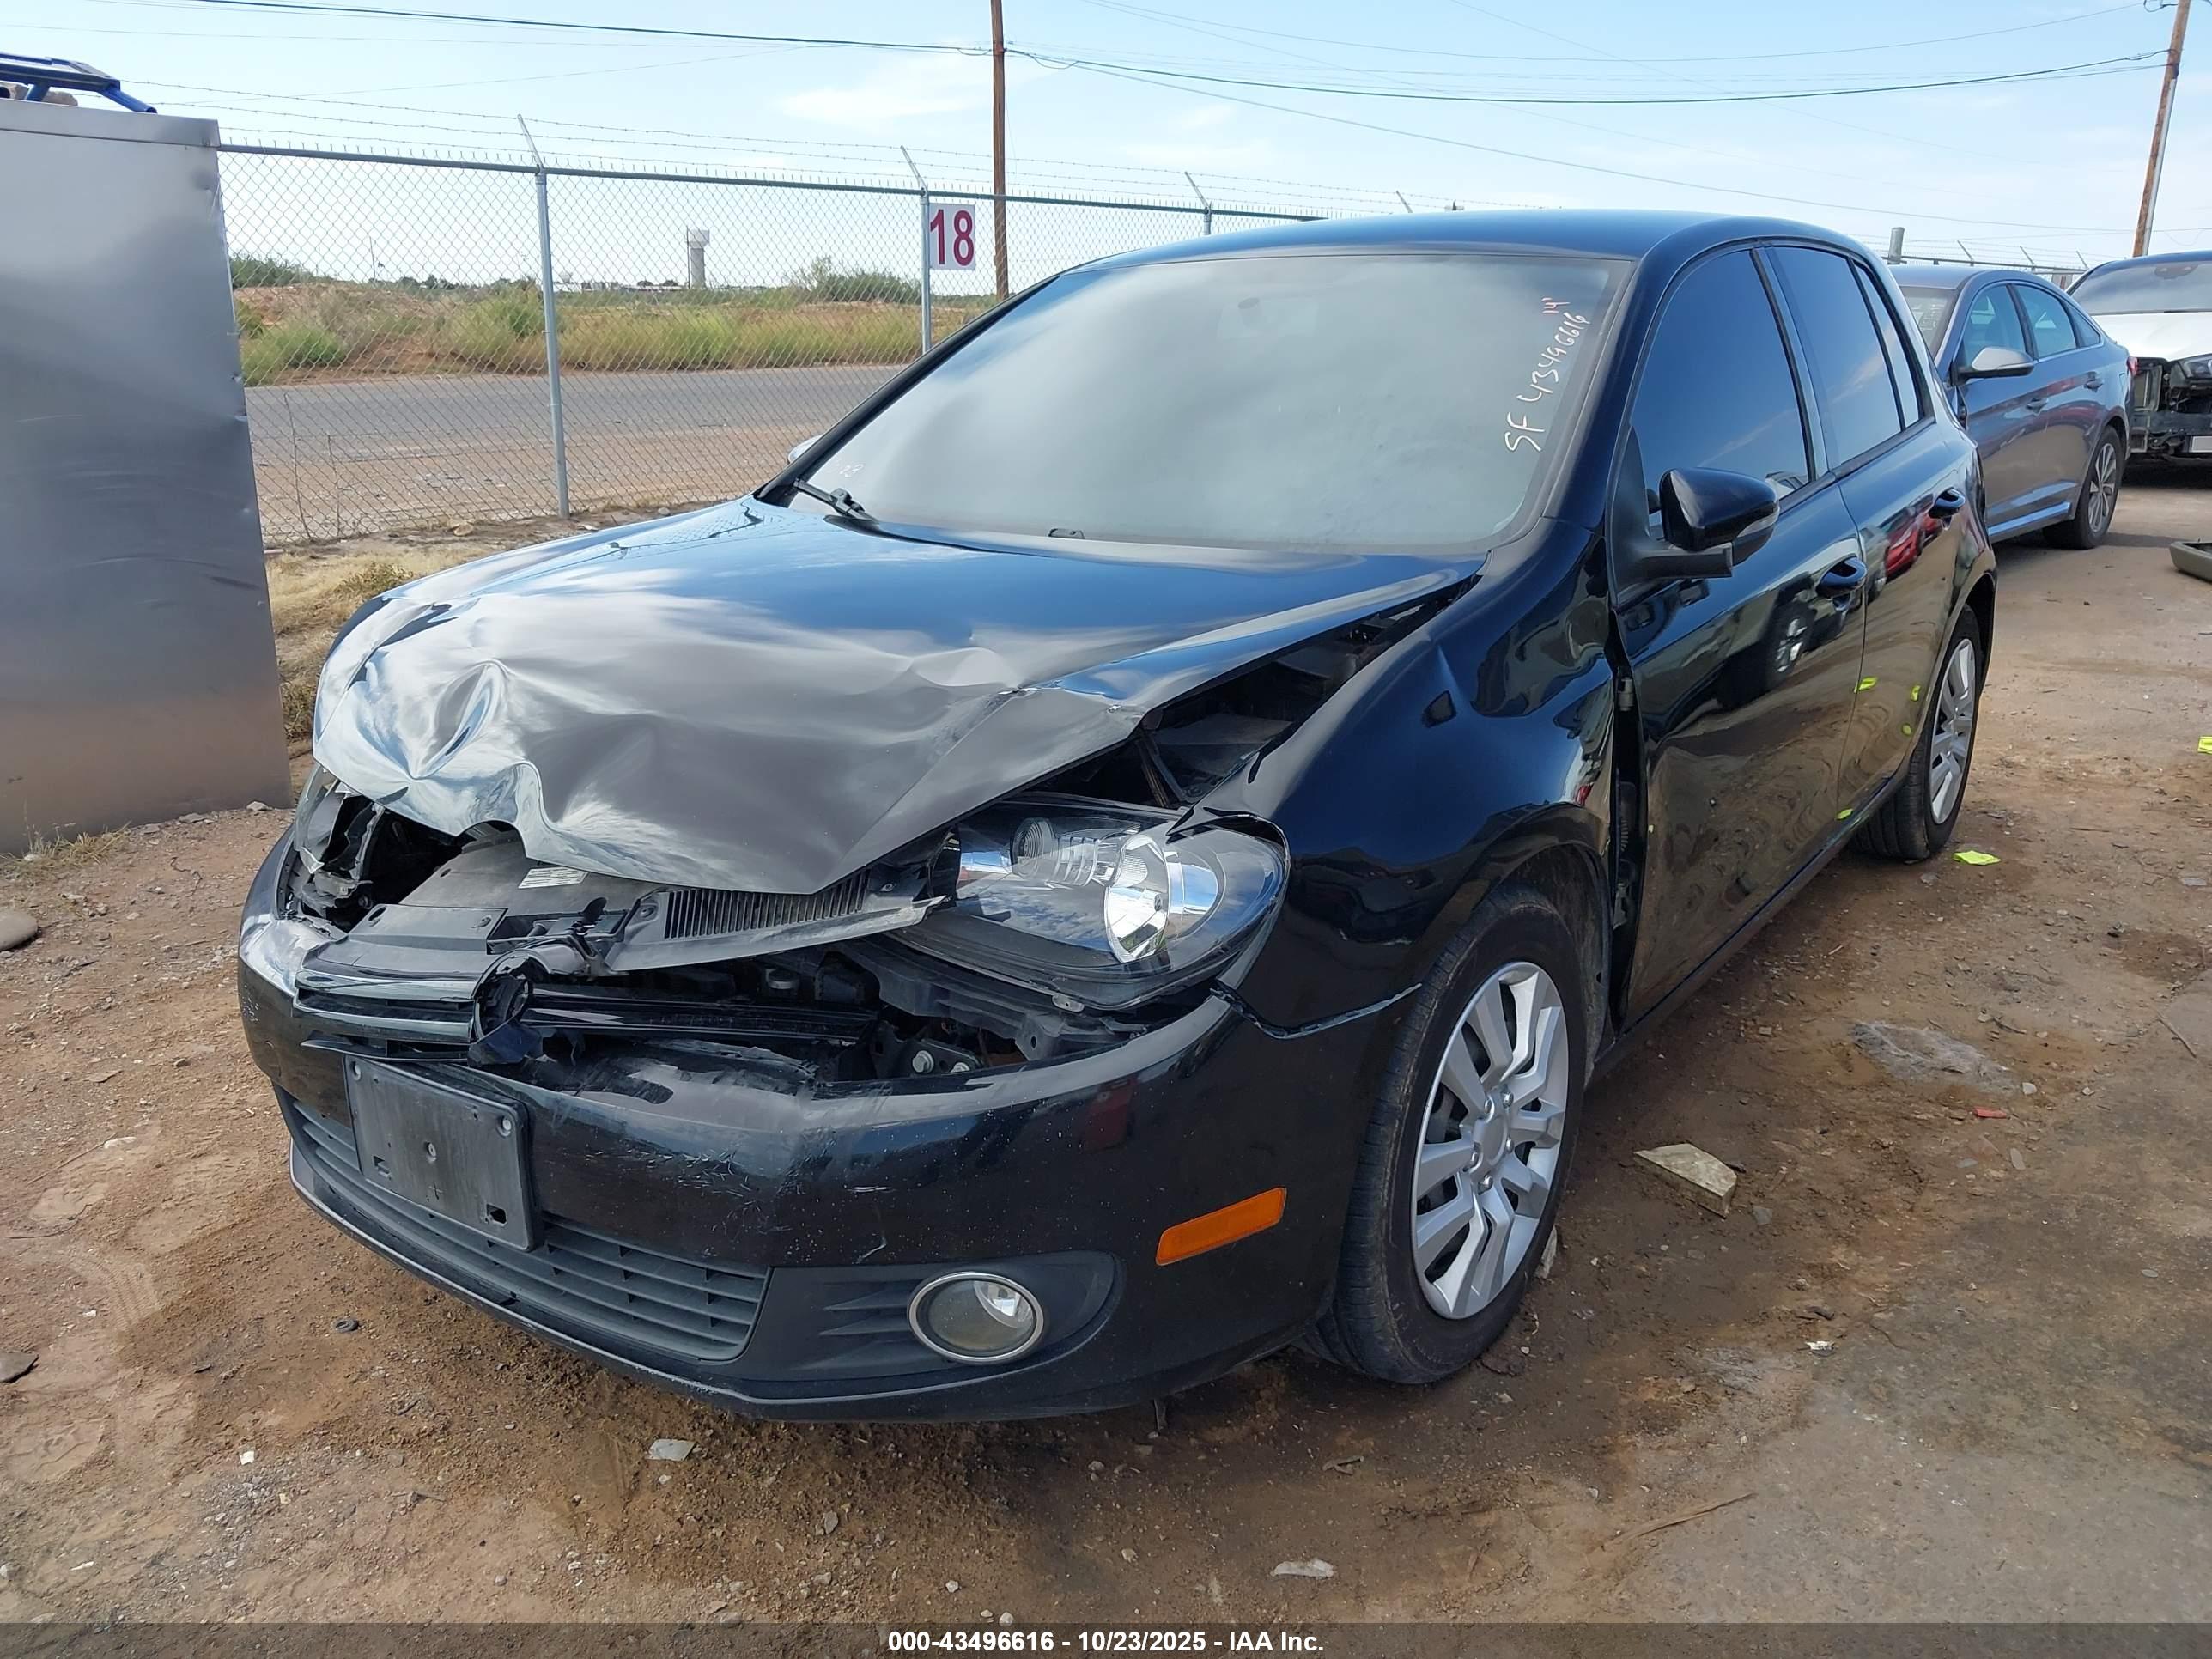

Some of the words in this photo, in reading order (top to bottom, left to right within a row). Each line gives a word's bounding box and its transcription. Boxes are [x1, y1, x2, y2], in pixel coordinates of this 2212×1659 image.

[930, 209, 974, 266] 18
[1516, 312, 1590, 402] 43496616
[1504, 411, 1545, 451] SF
